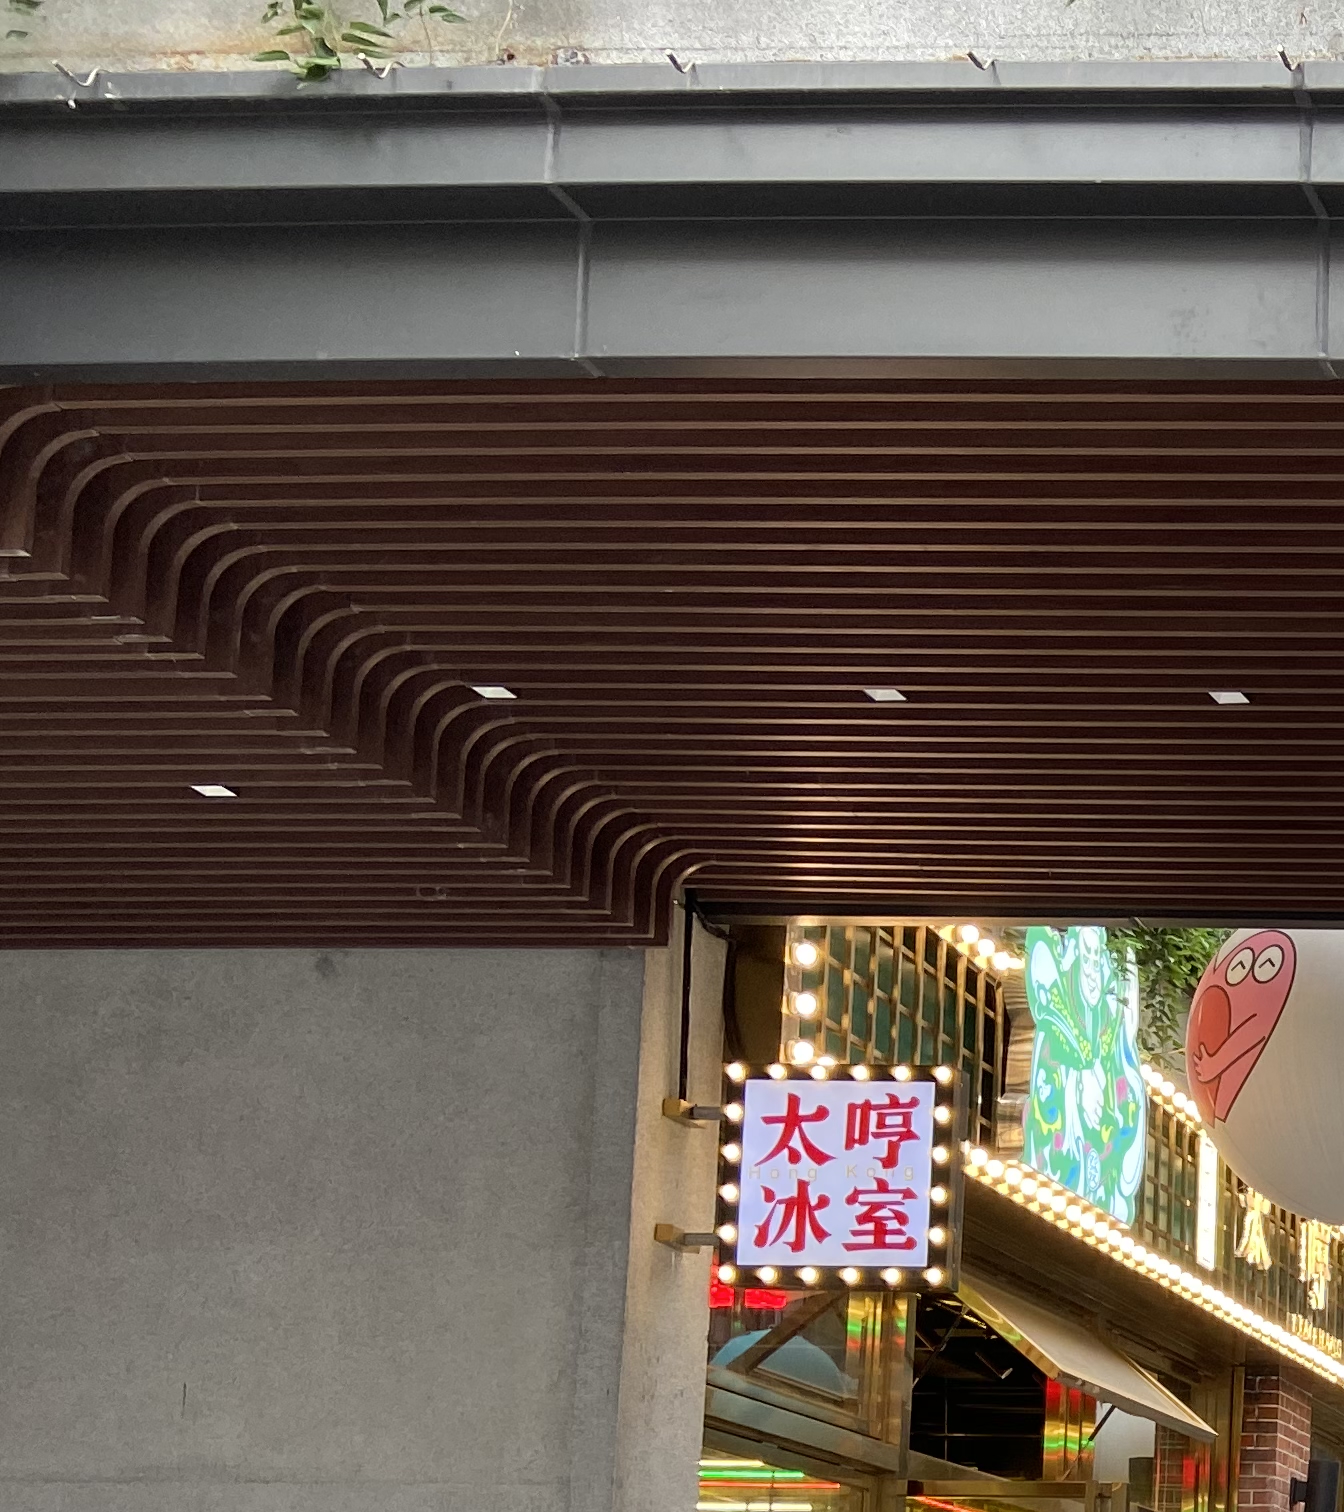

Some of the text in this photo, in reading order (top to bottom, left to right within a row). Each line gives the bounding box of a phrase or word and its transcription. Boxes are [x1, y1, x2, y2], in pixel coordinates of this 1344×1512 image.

[754, 1092, 922, 1170] 太哼
[749, 1165, 915, 1182] Hong Kong
[753, 1177, 919, 1253] 冰室
